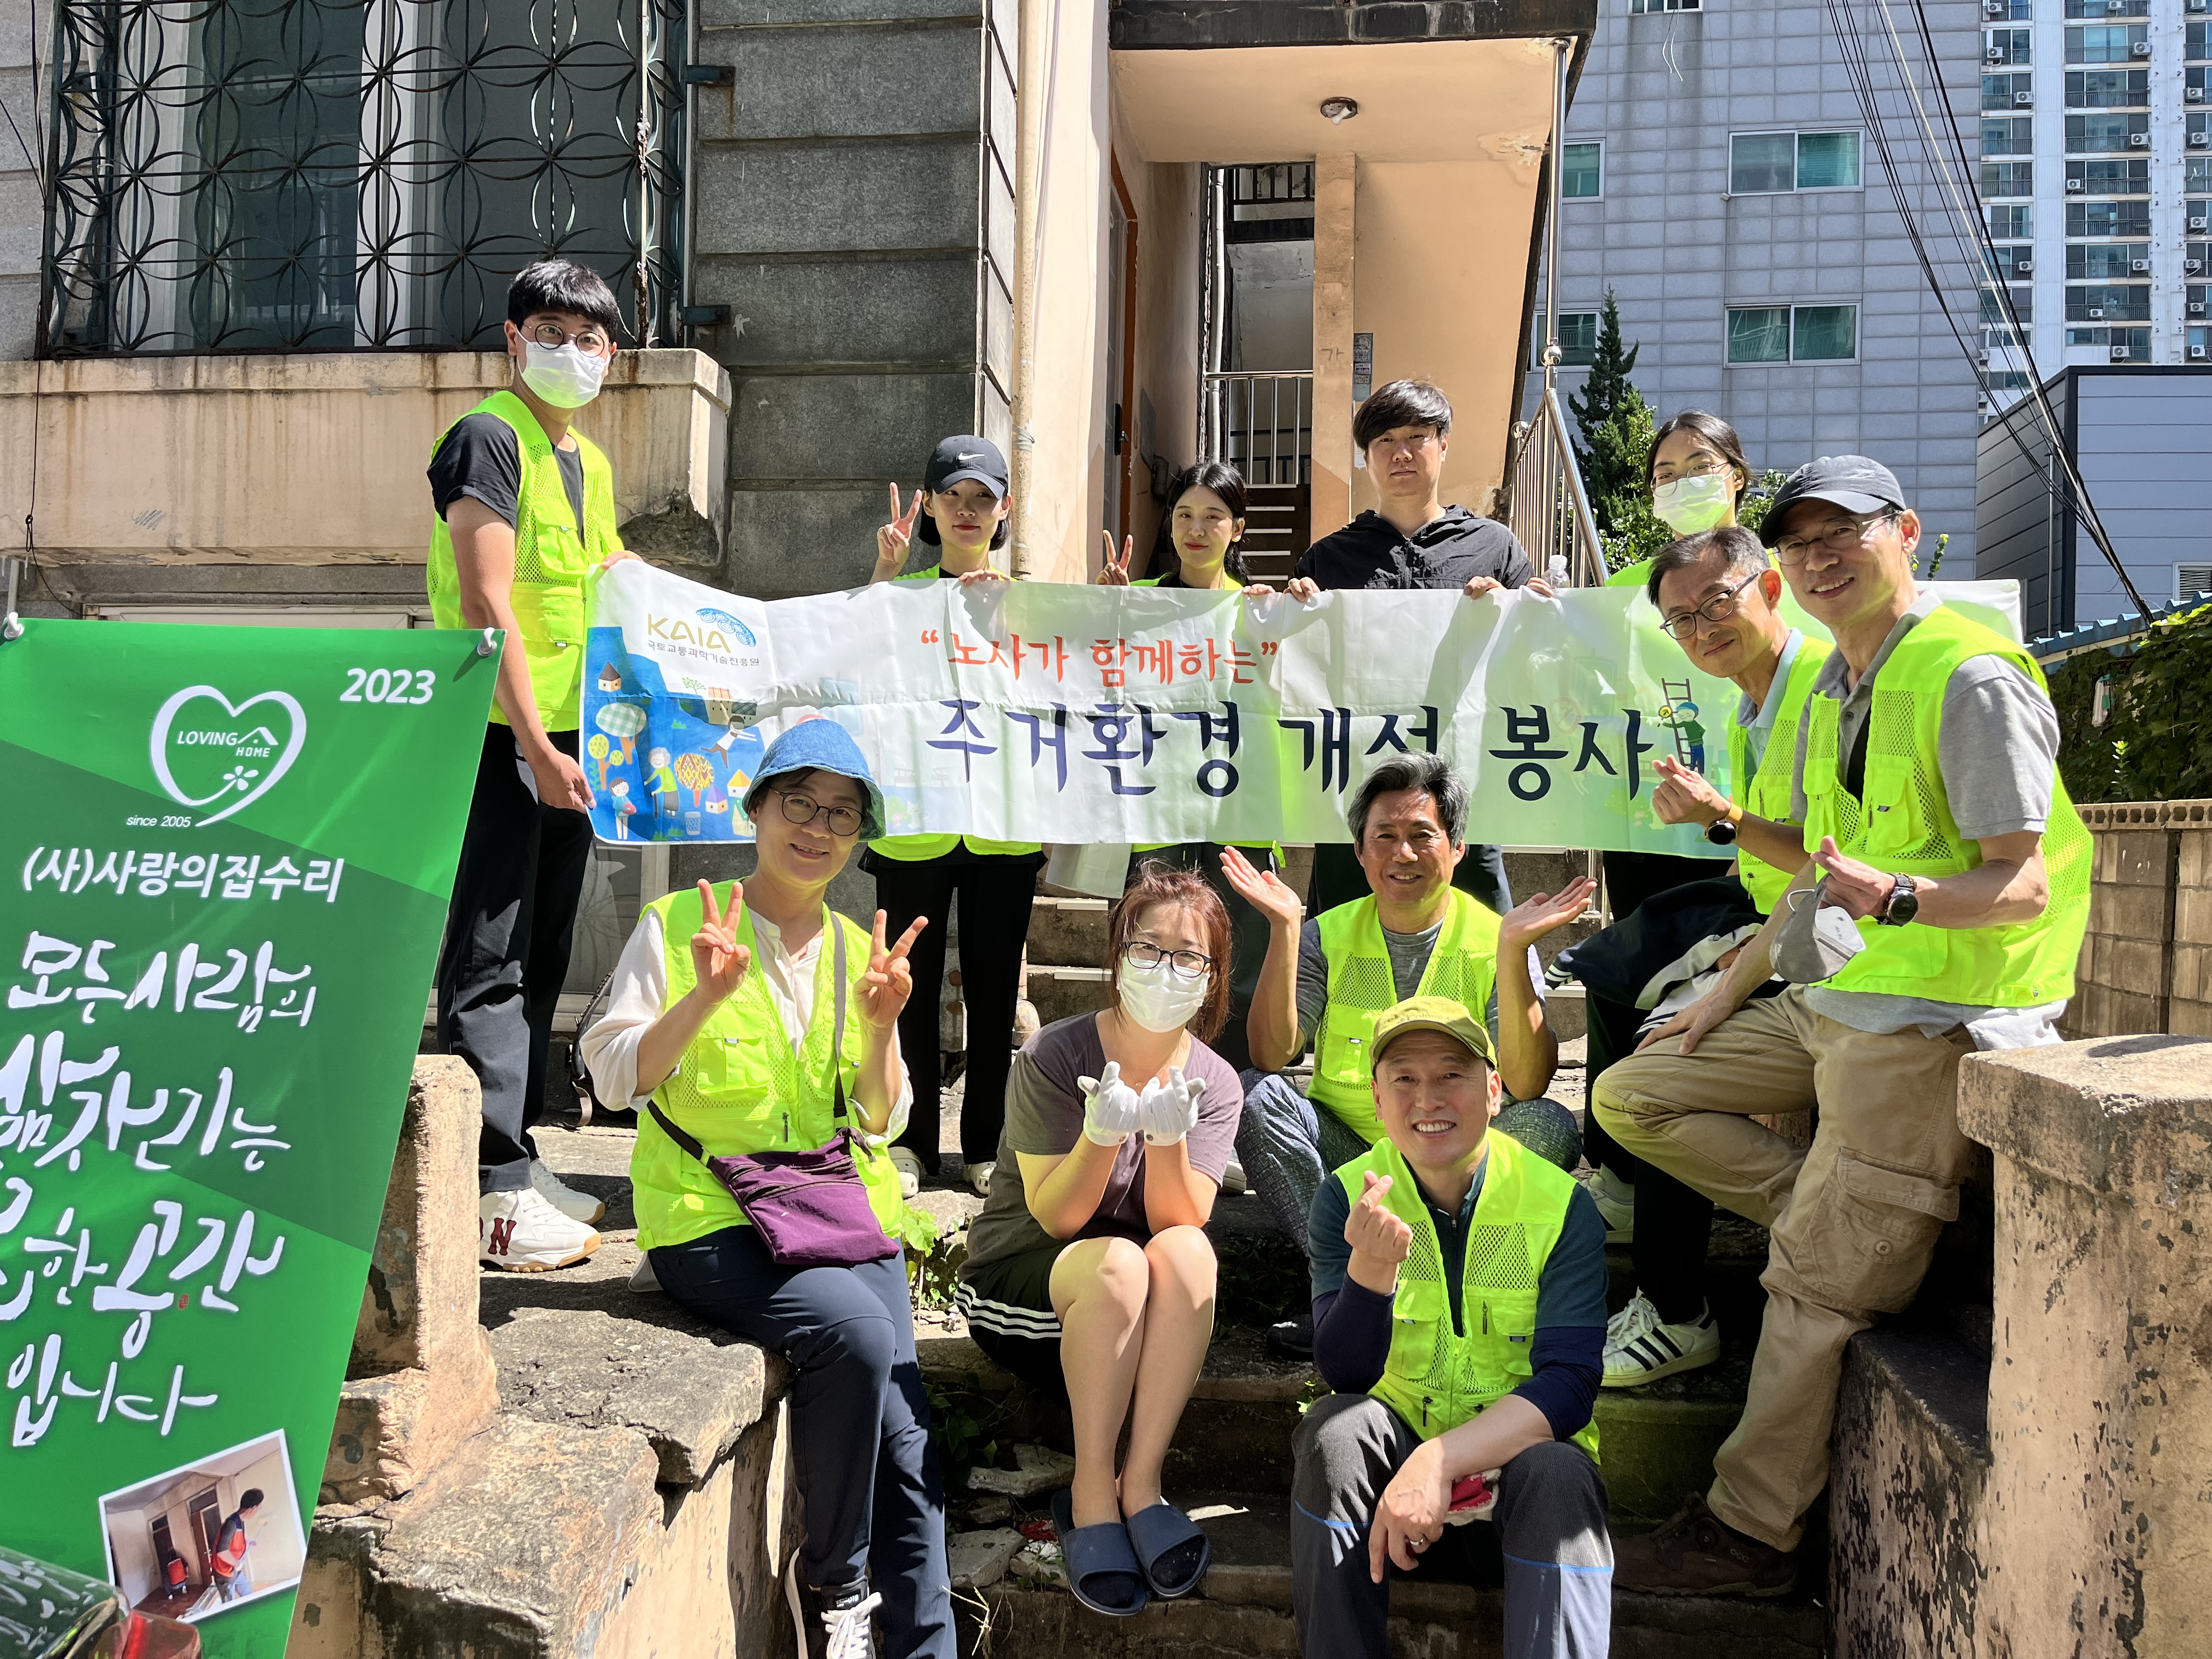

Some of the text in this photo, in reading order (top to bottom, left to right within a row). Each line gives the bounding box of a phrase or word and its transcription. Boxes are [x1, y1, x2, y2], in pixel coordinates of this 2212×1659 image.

[1321, 347, 1345, 361] 가
[648, 613, 731, 653] KAIA
[647, 639, 760, 667] 국토교통과학기술진흥원
[340, 668, 436, 705] 2023
[177, 730, 238, 746] LOVING
[235, 747, 270, 757] HOME
[926, 698, 1240, 798] 주거환경
[1488, 704, 1654, 801] 봉사
[126, 815, 191, 827] since 2005
[23, 847, 345, 902] (사)사랑의집수리
